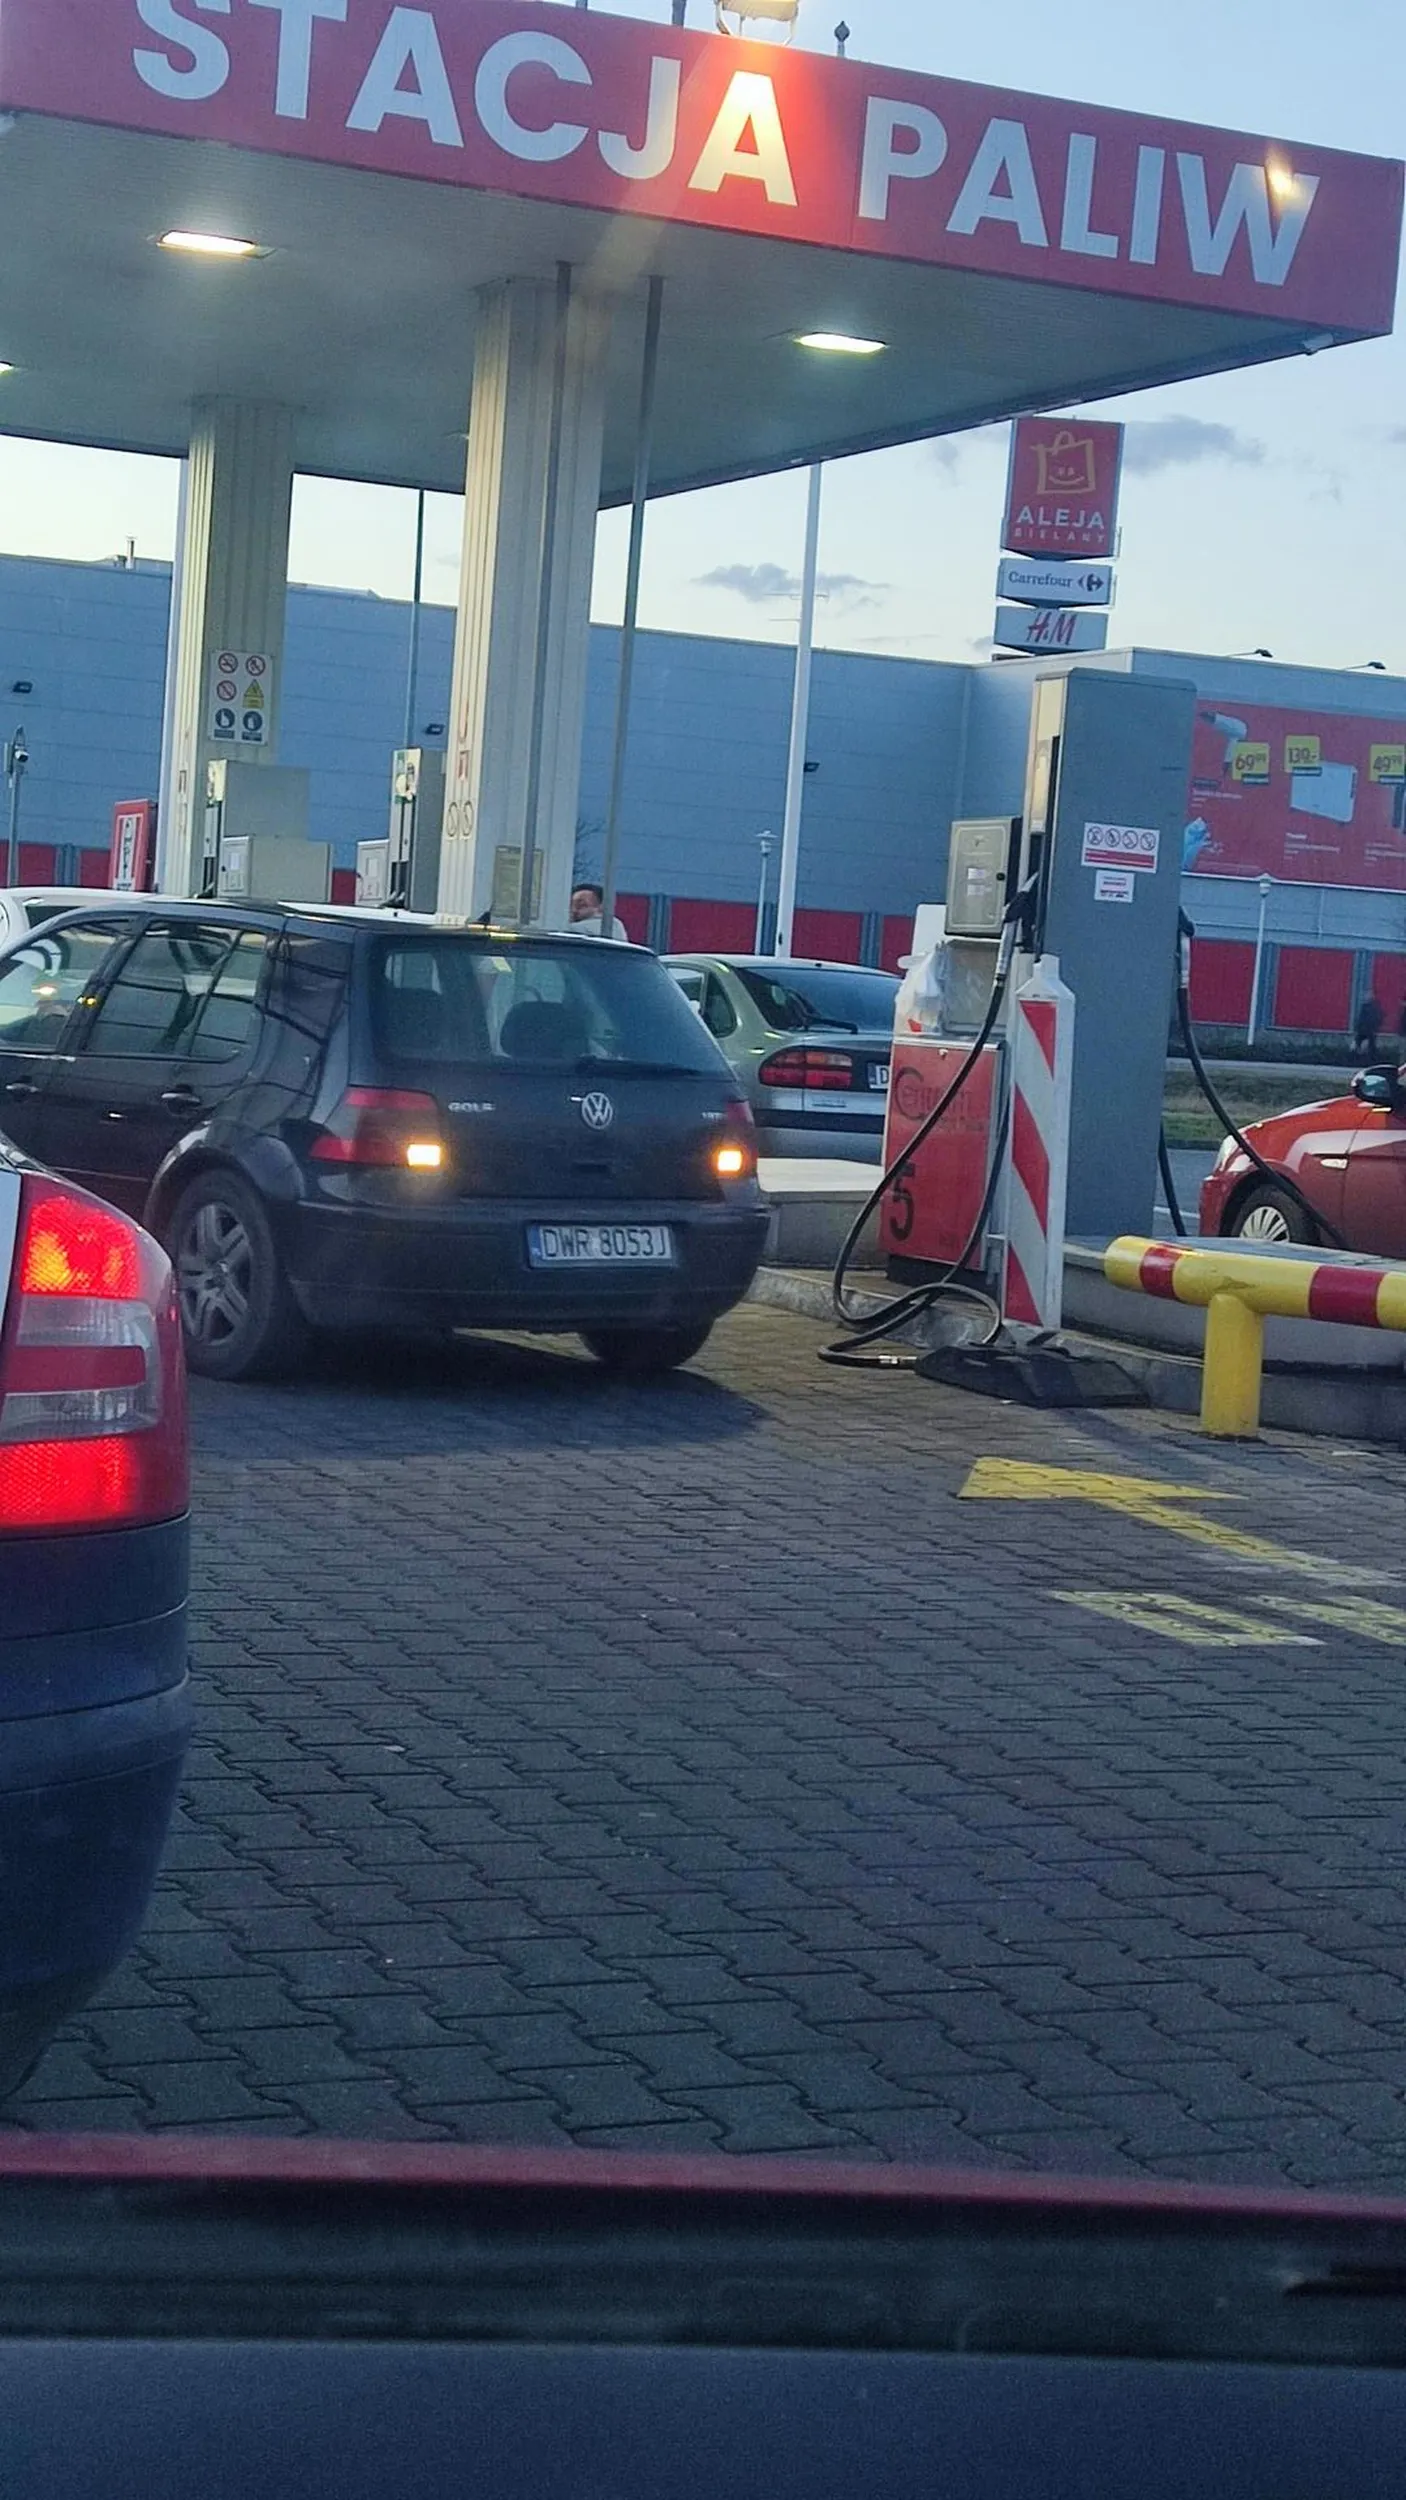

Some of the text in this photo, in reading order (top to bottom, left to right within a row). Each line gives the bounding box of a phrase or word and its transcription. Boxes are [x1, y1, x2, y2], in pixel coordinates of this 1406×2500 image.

[133, 0, 1320, 286] STACJA PALIW
[1016, 506, 1105, 530] ALEJA
[1014, 527, 1105, 543] BIELANY
[1008, 571, 1073, 588] Carrefour
[543, 1228, 666, 1257] DWR 8053J
